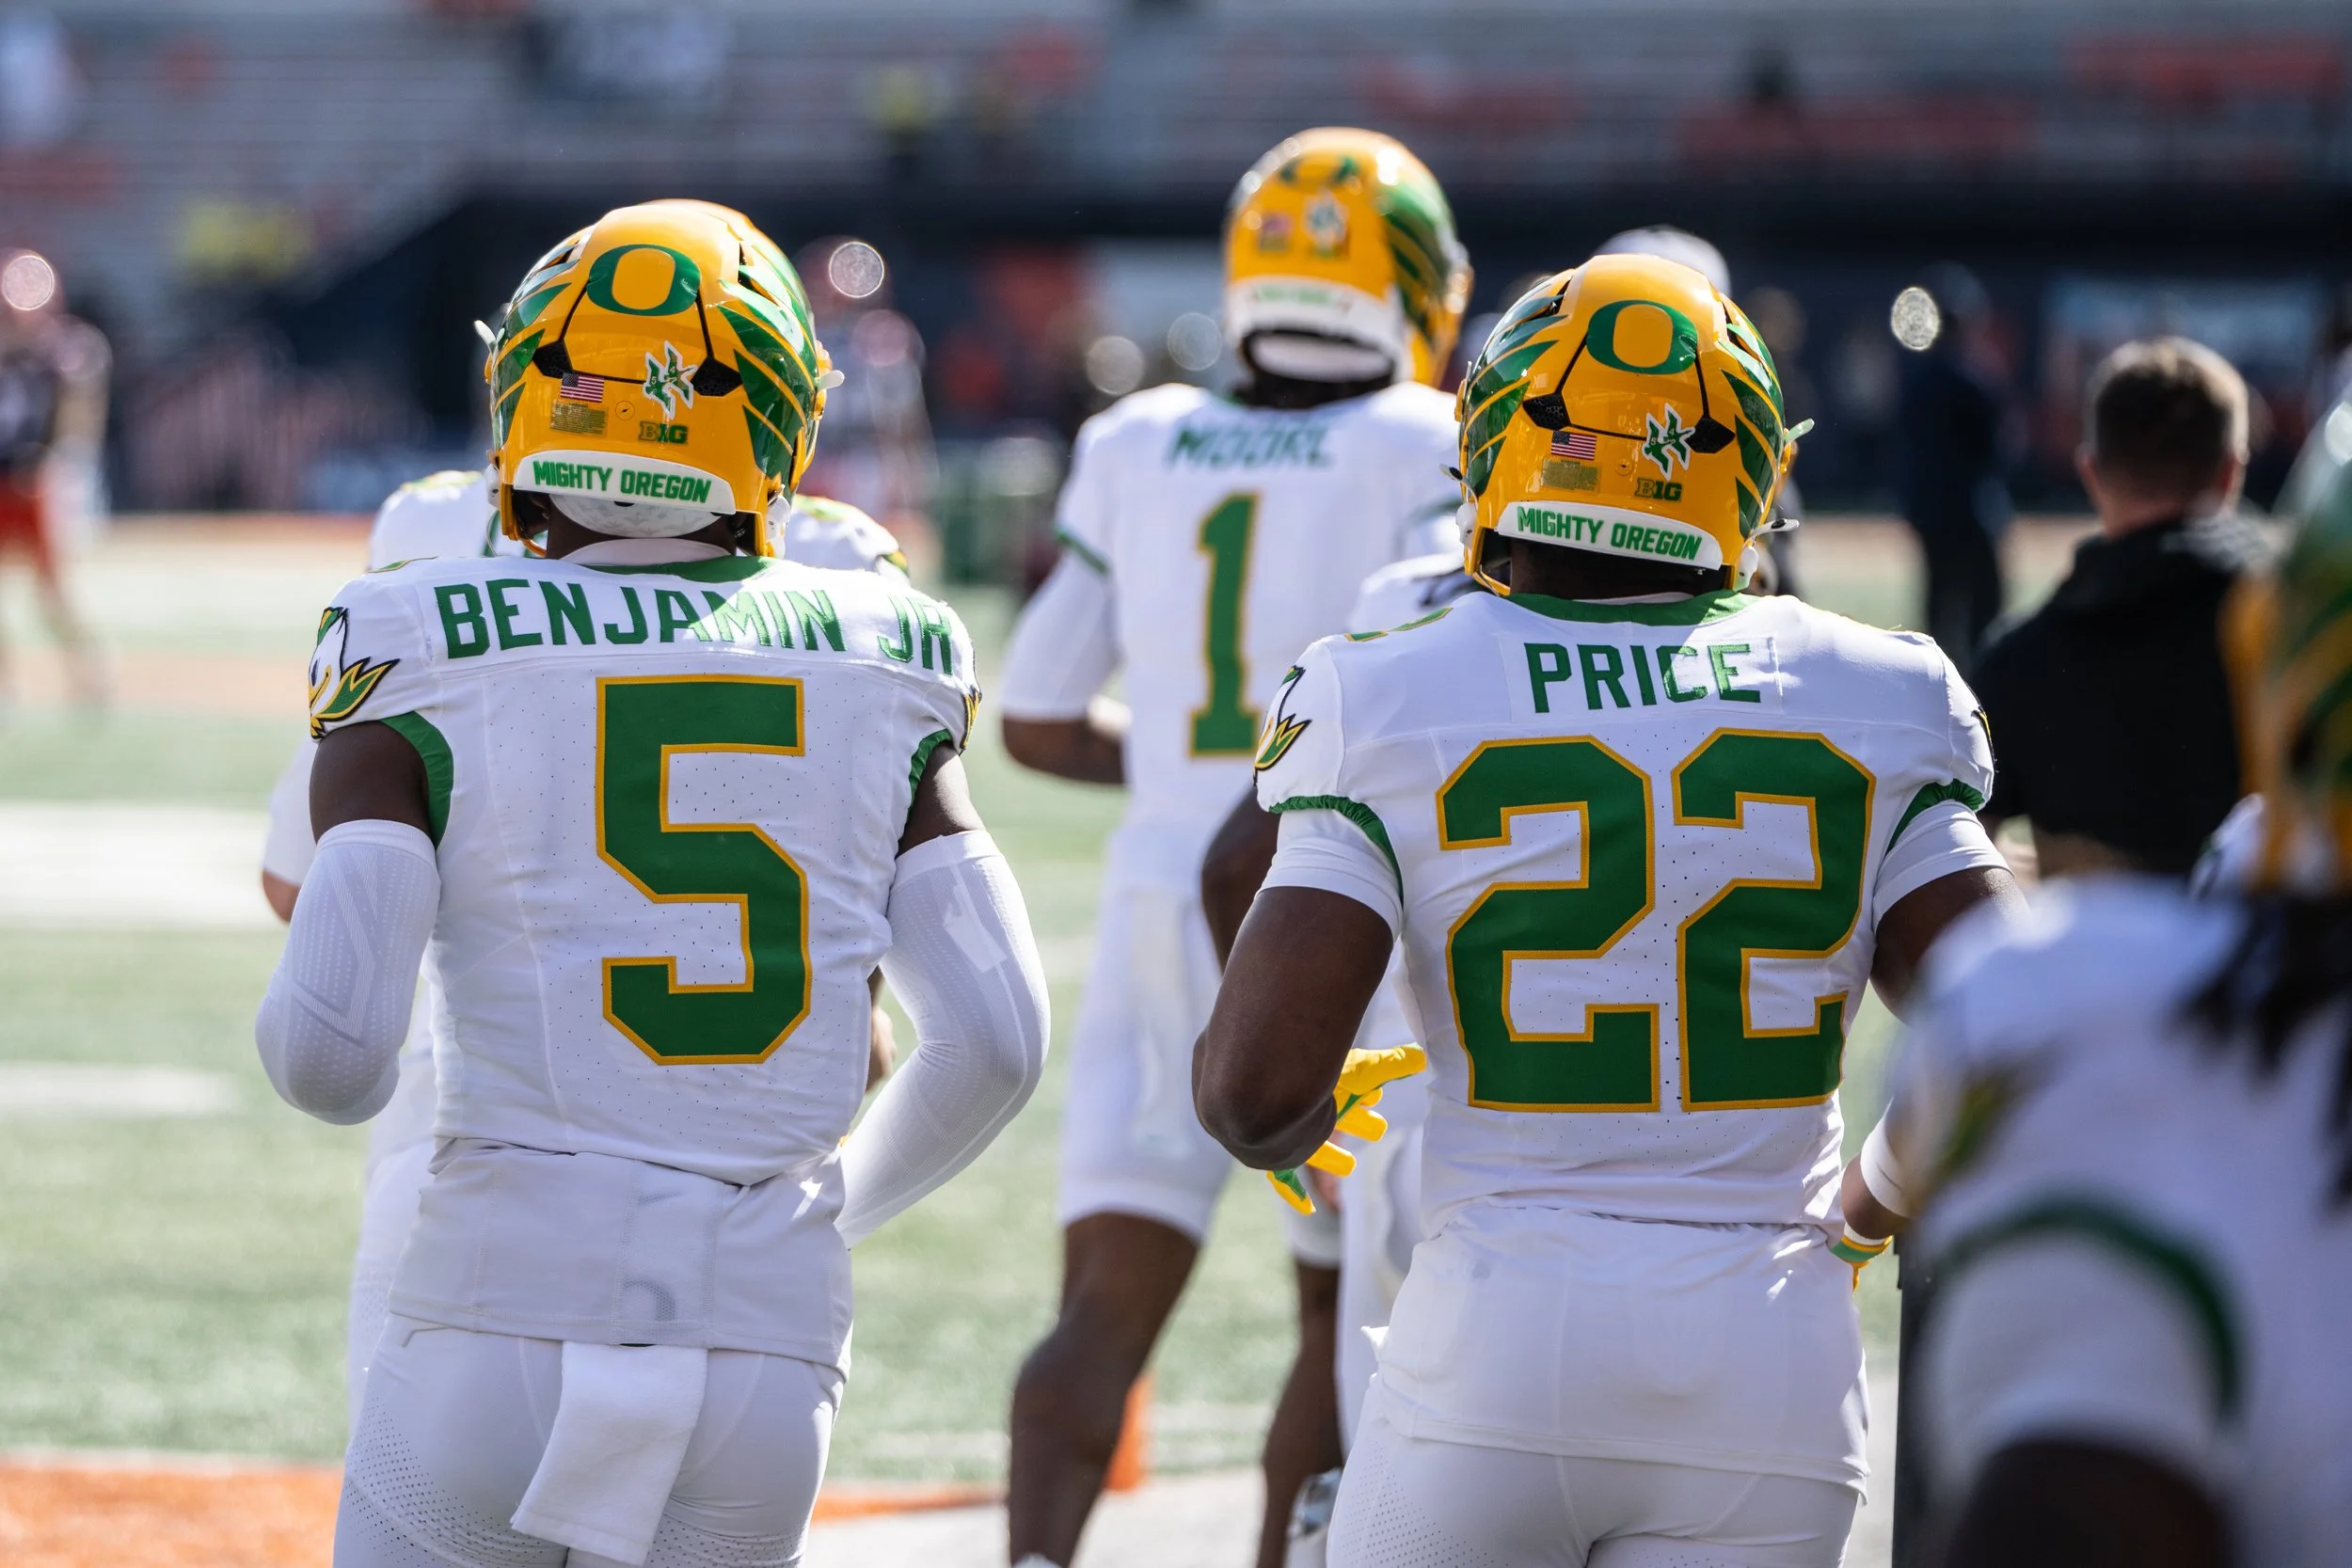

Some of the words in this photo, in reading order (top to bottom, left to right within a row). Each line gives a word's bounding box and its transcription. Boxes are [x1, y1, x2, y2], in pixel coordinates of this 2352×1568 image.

[587, 244, 702, 316] O
[1586, 300, 1698, 375] O
[532, 460, 613, 491] MIGHTY
[620, 469, 711, 503] OREGON
[1517, 506, 1603, 544] MIGHTY
[1610, 522, 1702, 561] OREGON
[434, 578, 847, 659] BENJAMIN
[877, 594, 952, 676] JR
[1188, 488, 1261, 760] 1
[1523, 641, 1761, 713] PRICE
[596, 673, 813, 1066] 5
[1436, 727, 1877, 1114] 22
